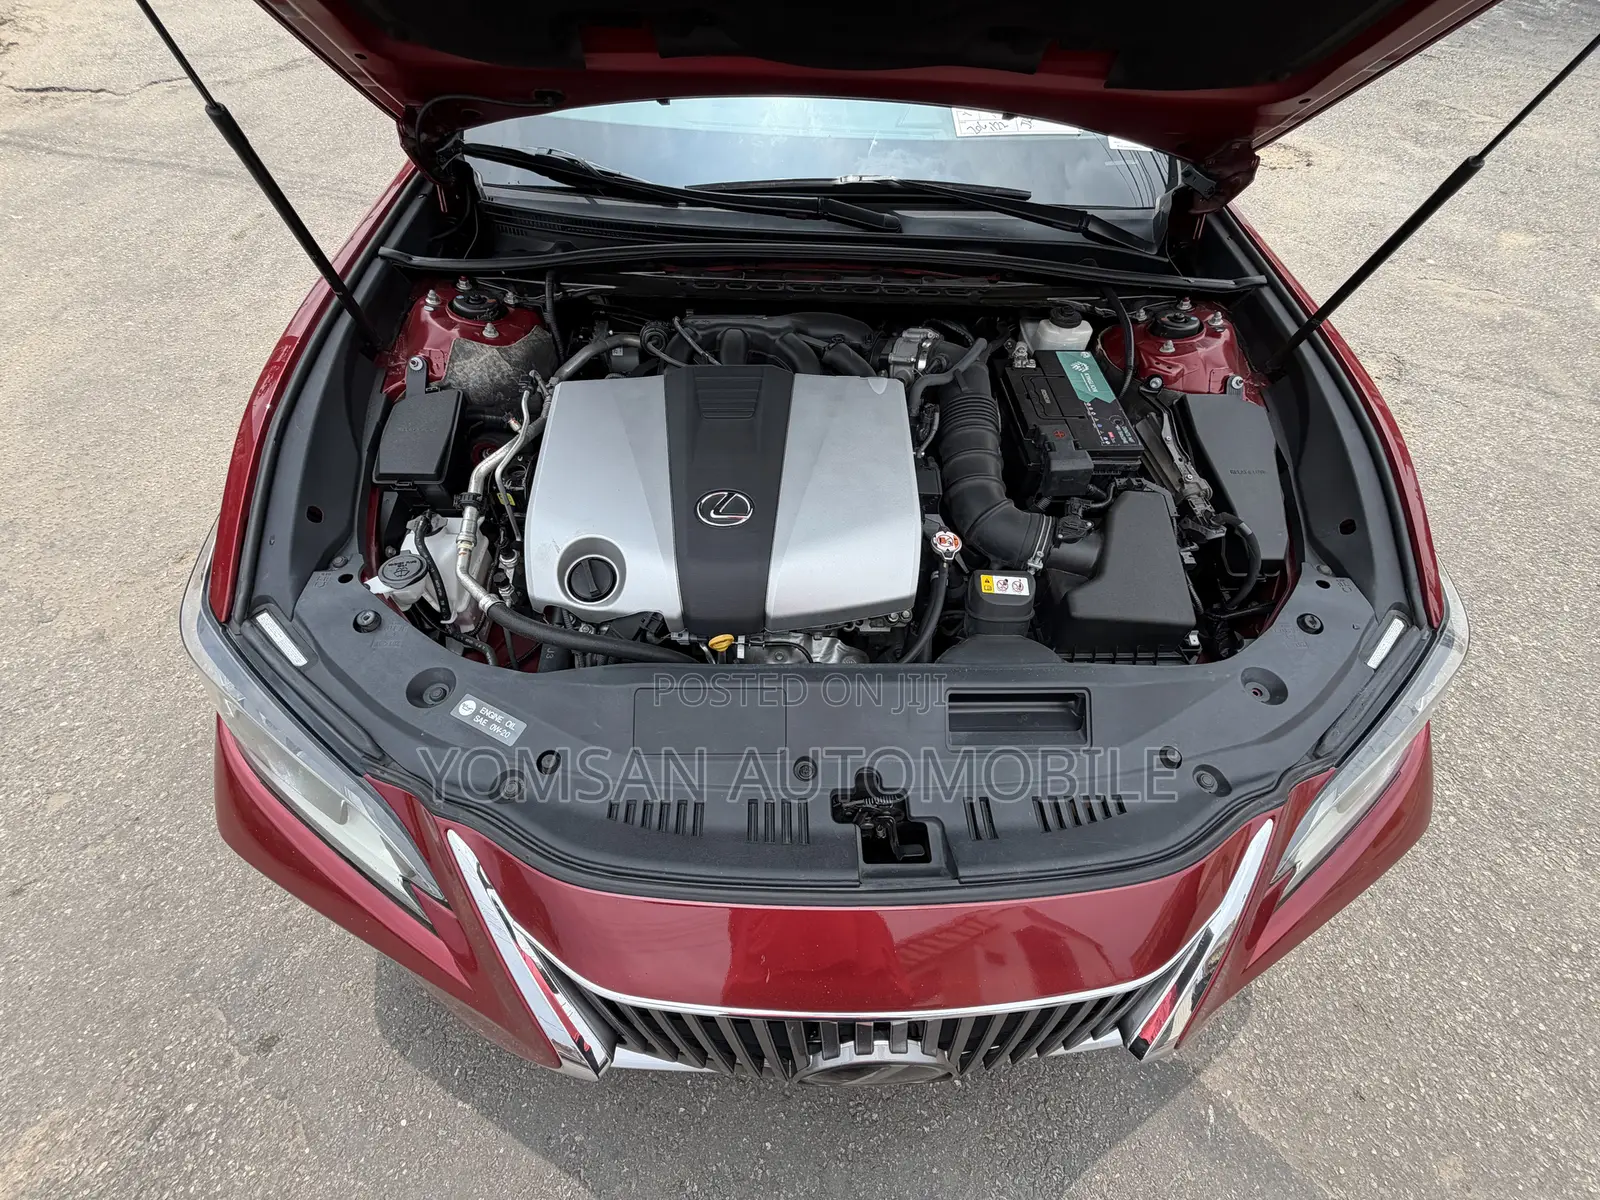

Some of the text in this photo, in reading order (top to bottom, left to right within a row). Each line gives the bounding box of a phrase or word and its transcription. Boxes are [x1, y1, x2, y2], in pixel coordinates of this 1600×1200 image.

[473, 714, 511, 739] SAE 0W-20
[479, 706, 517, 731] ENGINE OIL
